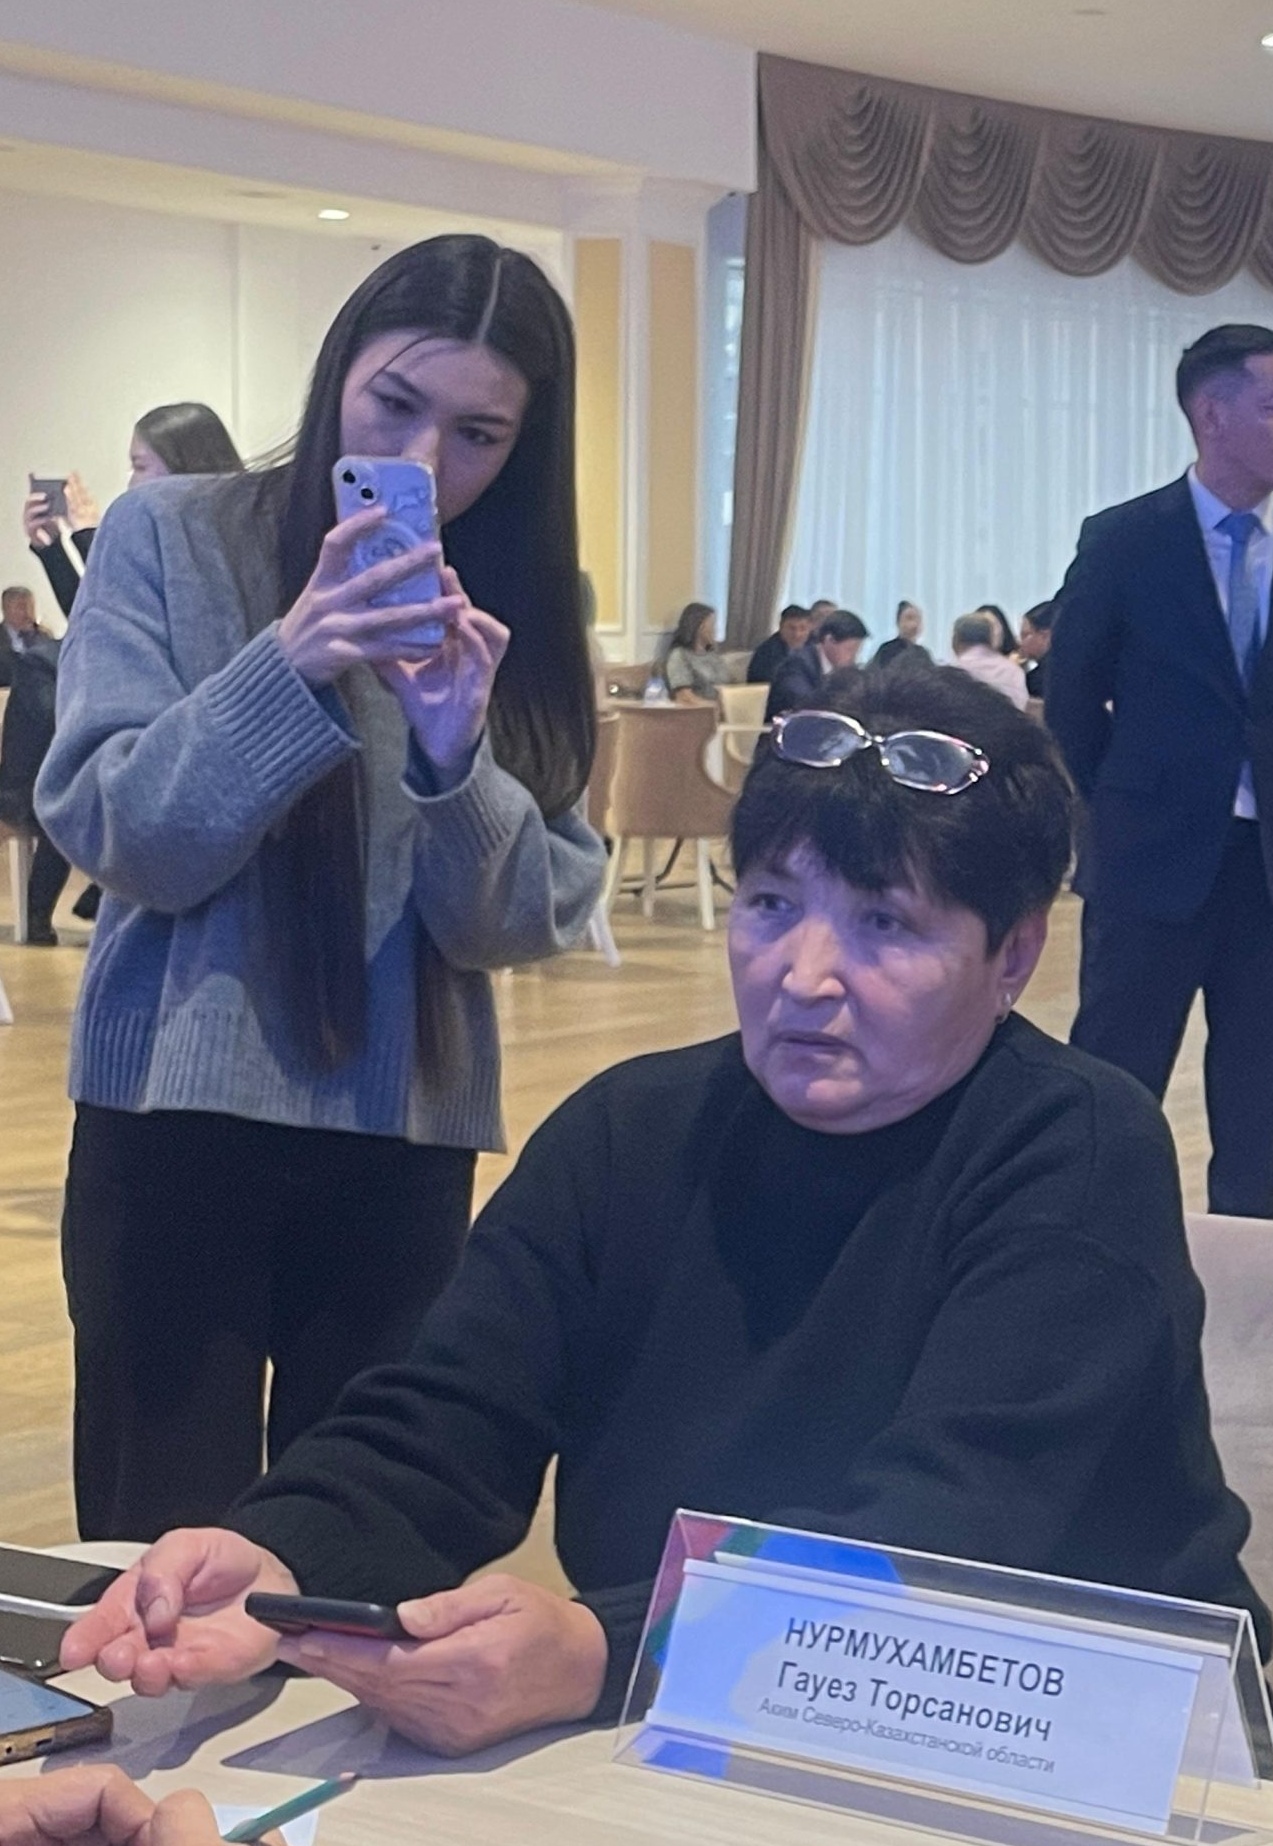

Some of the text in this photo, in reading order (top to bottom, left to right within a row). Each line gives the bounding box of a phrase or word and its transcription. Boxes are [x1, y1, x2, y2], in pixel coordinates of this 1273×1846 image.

[784, 1617, 1065, 1696] НУРМУХАМБЕТОВ
[757, 1698, 799, 1720] Аким
[986, 1746, 1056, 1774] области
[777, 1661, 1052, 1742] Гауез Торсанович
